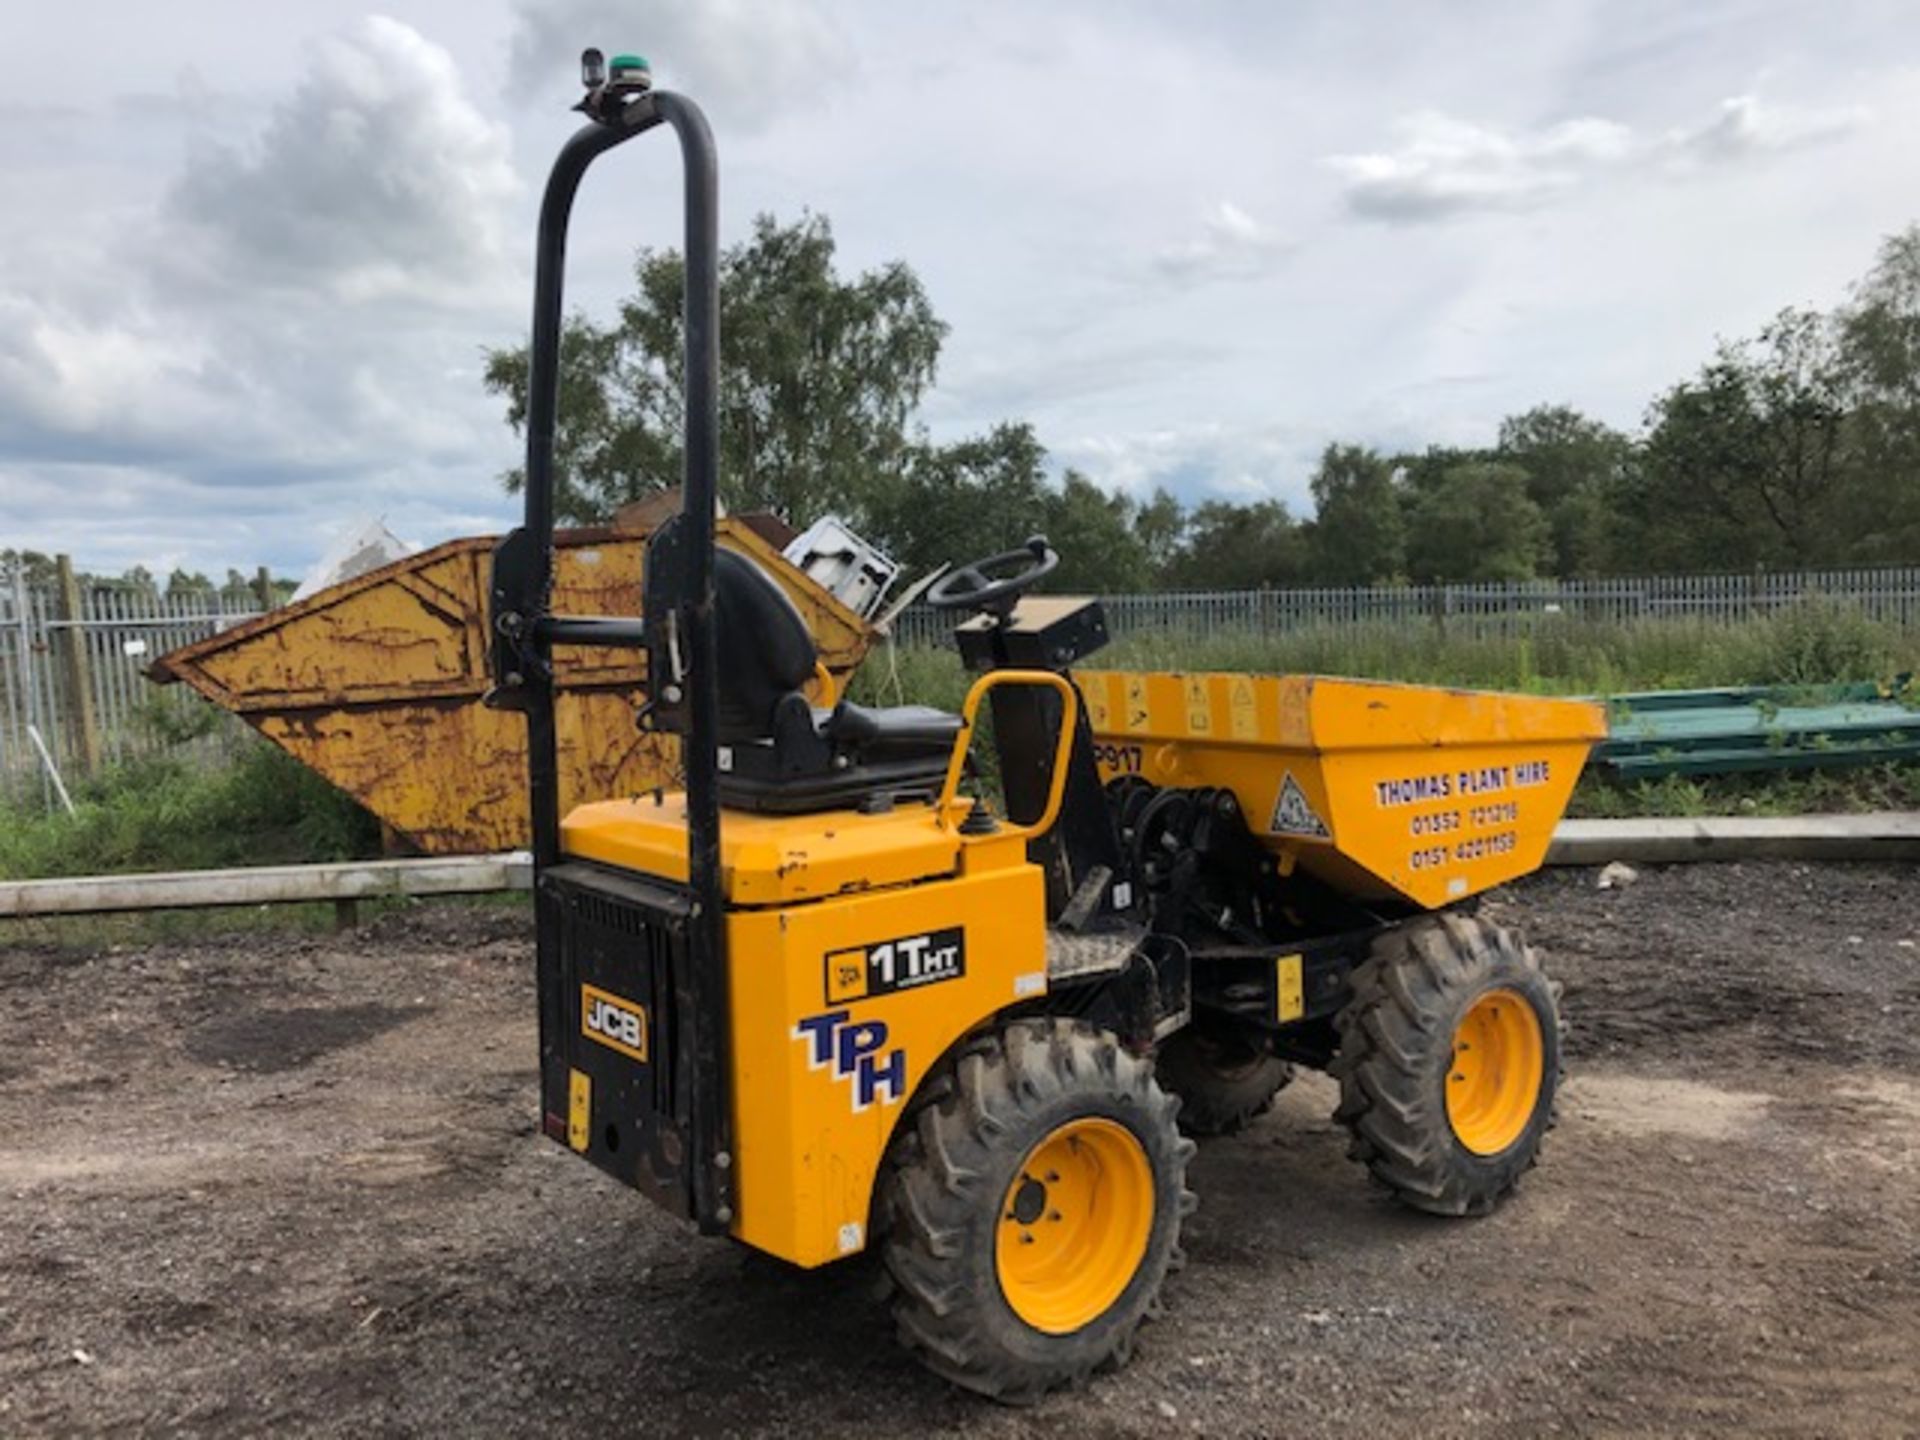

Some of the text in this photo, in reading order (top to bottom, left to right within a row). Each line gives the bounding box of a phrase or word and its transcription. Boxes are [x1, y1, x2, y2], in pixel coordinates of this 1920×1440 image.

[1377, 760, 1550, 806] THOMAS PLANT HIRE
[1412, 846, 1449, 869] 0151
[587, 999, 642, 1049] JCB
